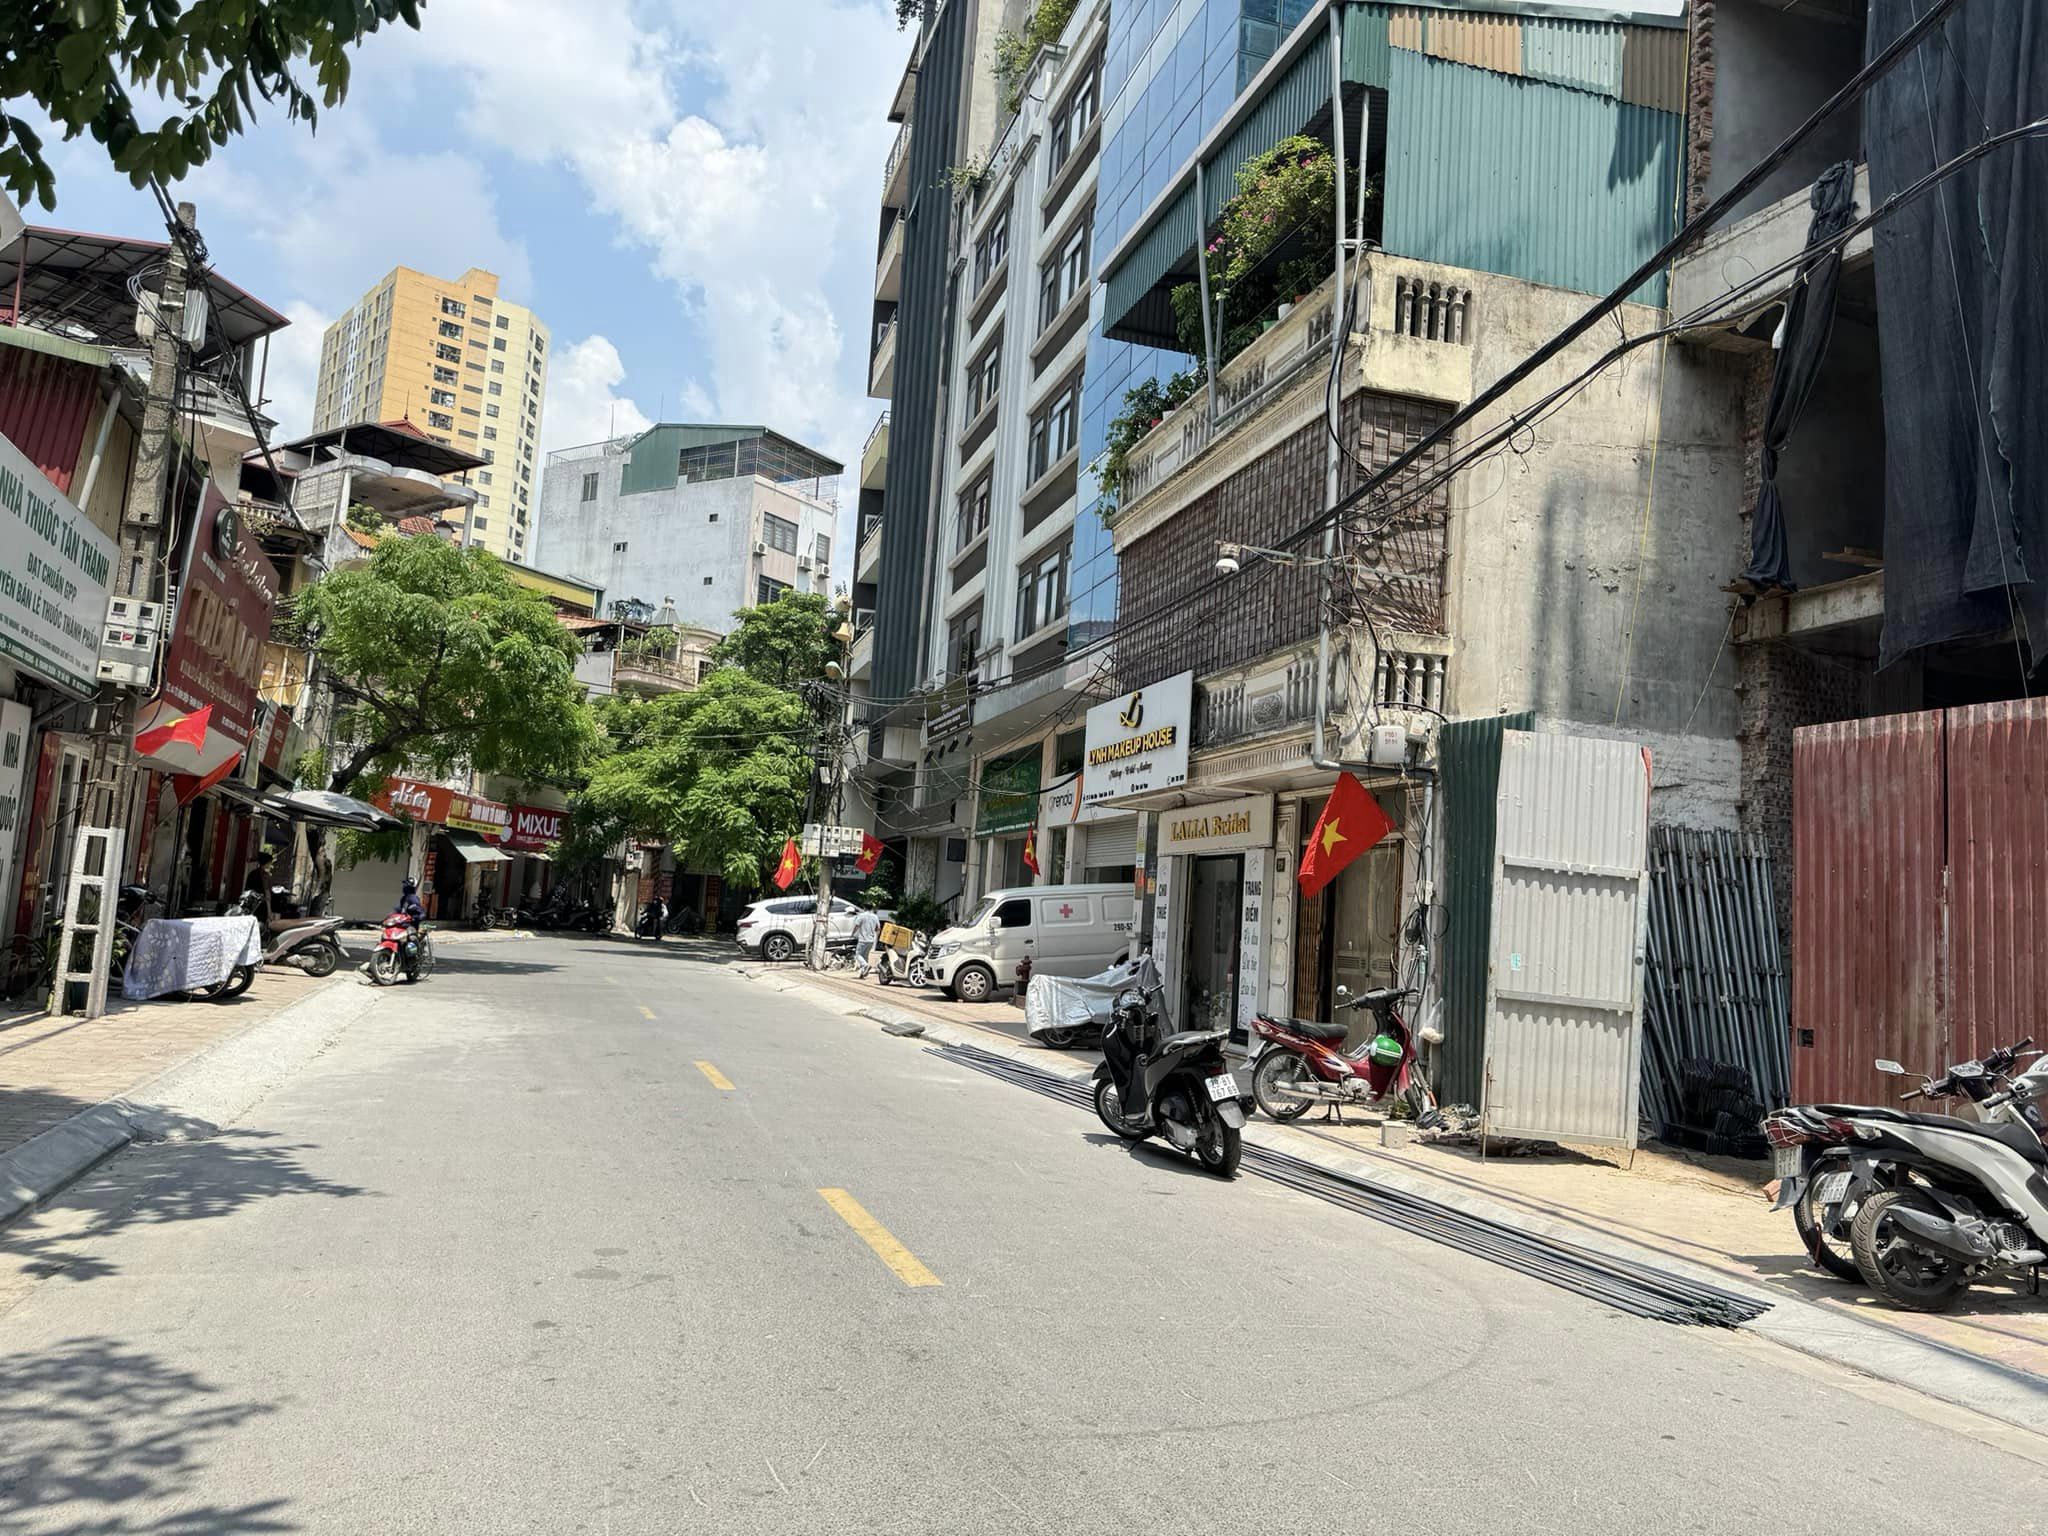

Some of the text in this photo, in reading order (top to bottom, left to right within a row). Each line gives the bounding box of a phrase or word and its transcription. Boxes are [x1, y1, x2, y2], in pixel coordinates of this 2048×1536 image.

[0, 465, 24, 518] NHÀ
[25, 489, 60, 546] THUỐC
[80, 539, 110, 588] THÀNH
[3, 727, 22, 770] NHÀ
[1107, 735, 1142, 762] MAKEUP
[1142, 726, 1174, 752] HOUSE
[517, 812, 561, 838] MIXUE
[1211, 810, 1250, 837] Bridal
